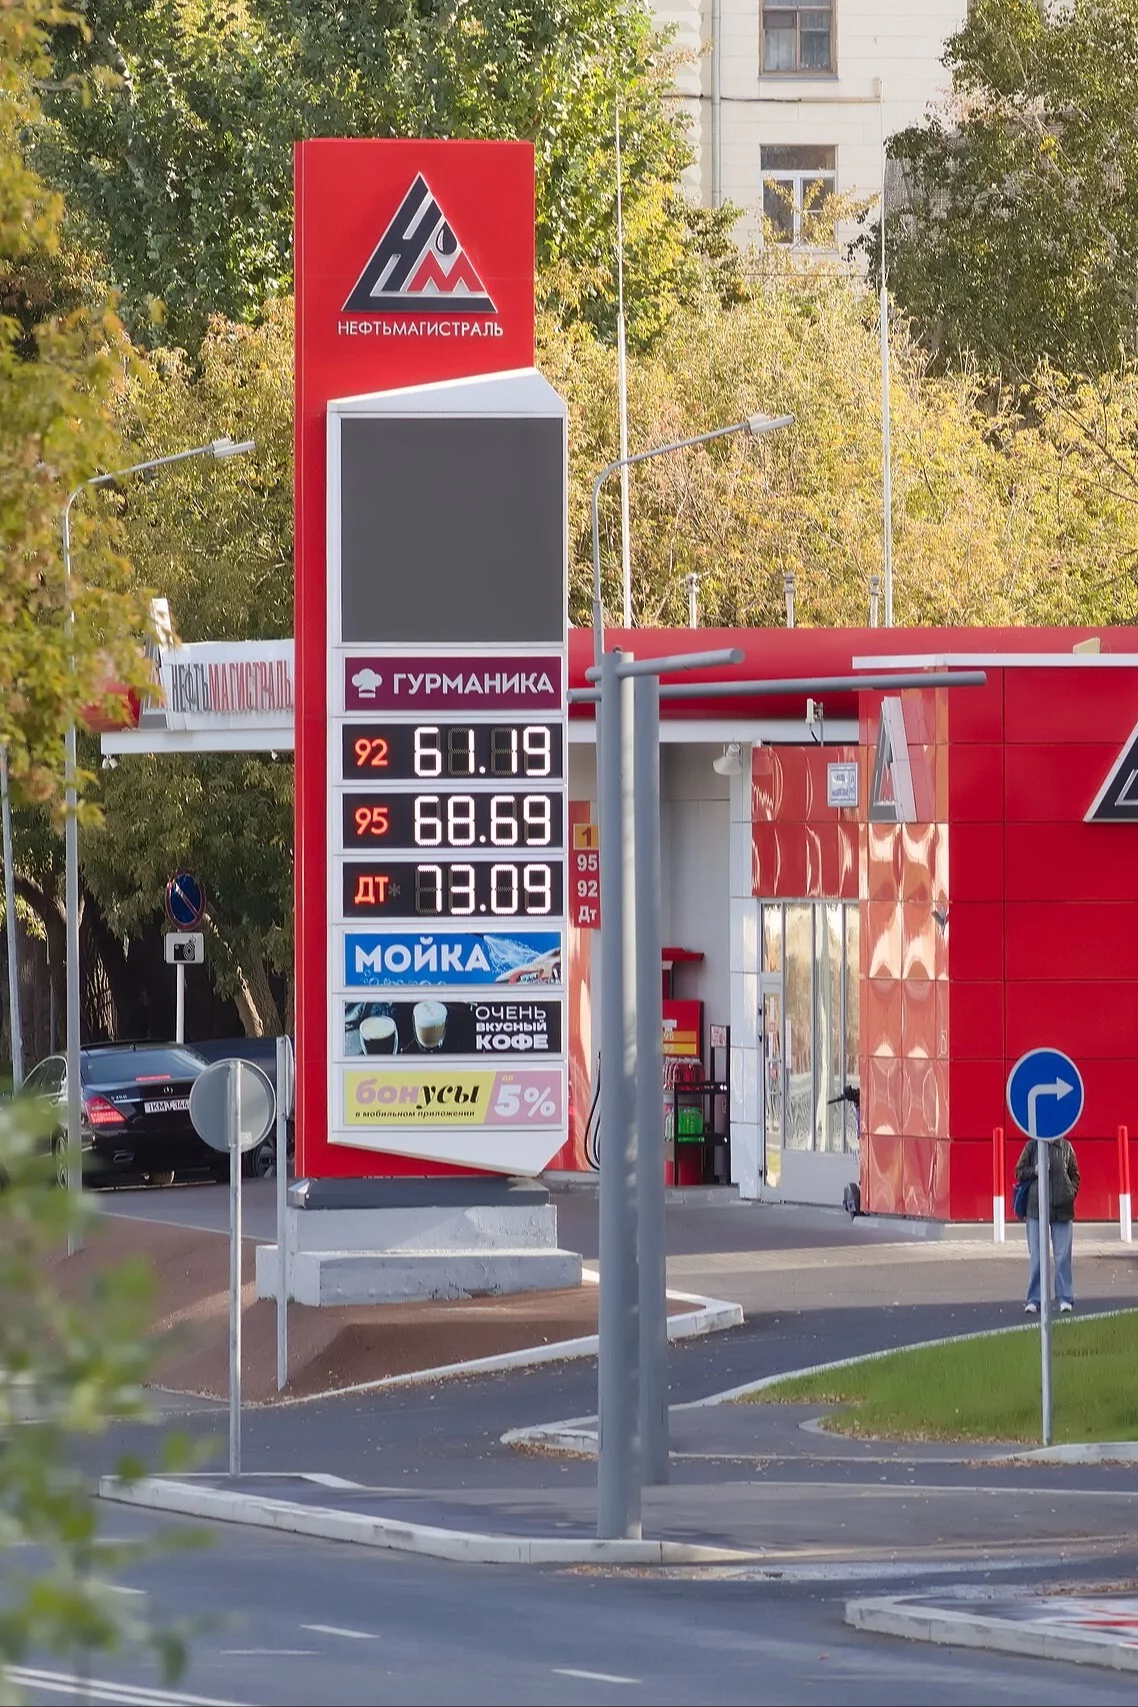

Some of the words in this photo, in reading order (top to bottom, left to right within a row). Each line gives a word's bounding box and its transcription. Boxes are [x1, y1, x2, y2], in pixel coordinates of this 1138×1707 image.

[337, 320, 504, 337] НЕФТЬМАГИСТРАЛЬ
[171, 660, 293, 713] НЕФТЬМАГИСТРАЛЬ
[393, 673, 554, 694] ГУРМАНИКА
[355, 738, 388, 766] 92
[414, 726, 551, 776] 61.19
[355, 807, 389, 835] 95
[414, 795, 551, 846] 68.69
[582, 826, 591, 847] 1
[577, 854, 598, 871] 95
[416, 864, 551, 915] 73.09
[577, 880, 598, 897] 92
[355, 937, 491, 973] МОЙКА
[475, 1005, 546, 1020] ОЧЕНЬ
[475, 1019, 547, 1032] ВКУСНЫЙ
[476, 1034, 549, 1050] КОФЕ
[355, 1078, 480, 1109] бонусы
[494, 1084, 556, 1118] 5%
[362, 1109, 416, 1118] мобильном
[417, 1110, 475, 1119] приложении
